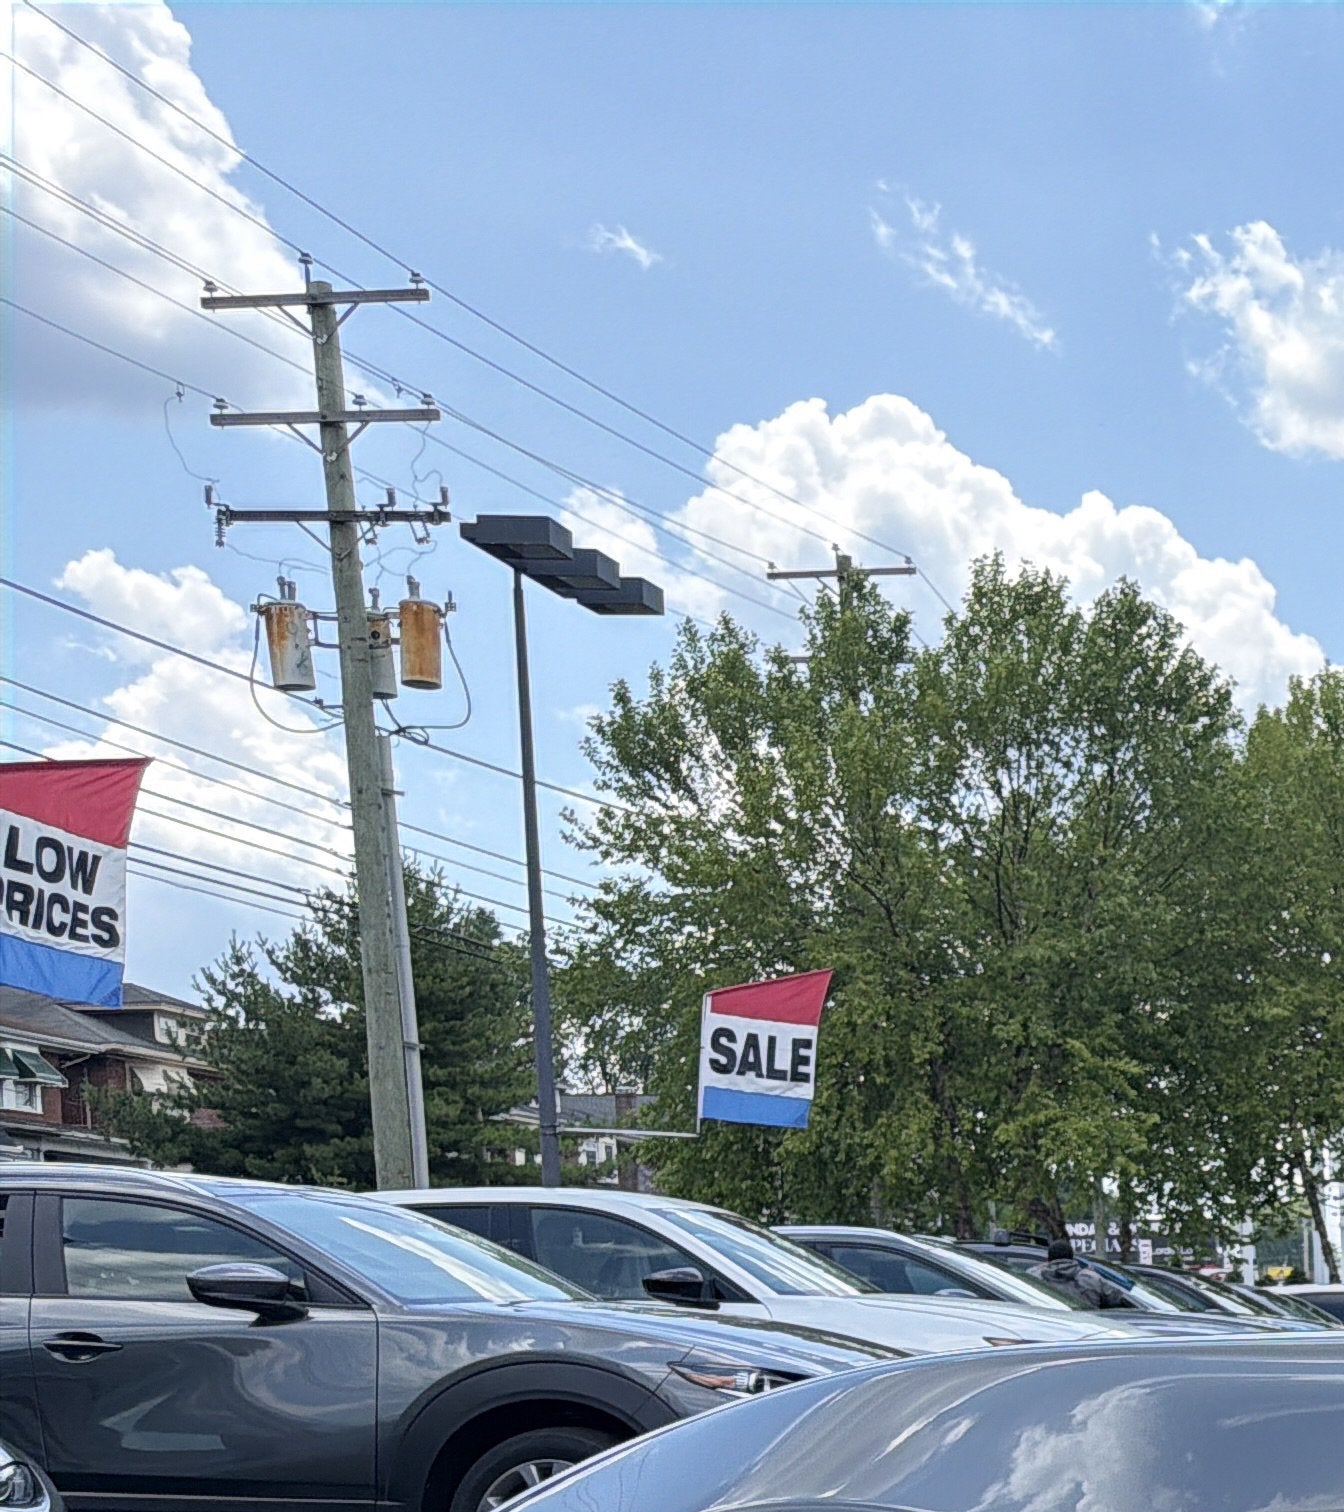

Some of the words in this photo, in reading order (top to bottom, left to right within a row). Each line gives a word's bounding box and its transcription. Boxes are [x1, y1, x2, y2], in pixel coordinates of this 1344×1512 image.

[3, 824, 103, 897] LOW
[0, 876, 120, 949] RICES
[708, 1026, 813, 1084] SALE
